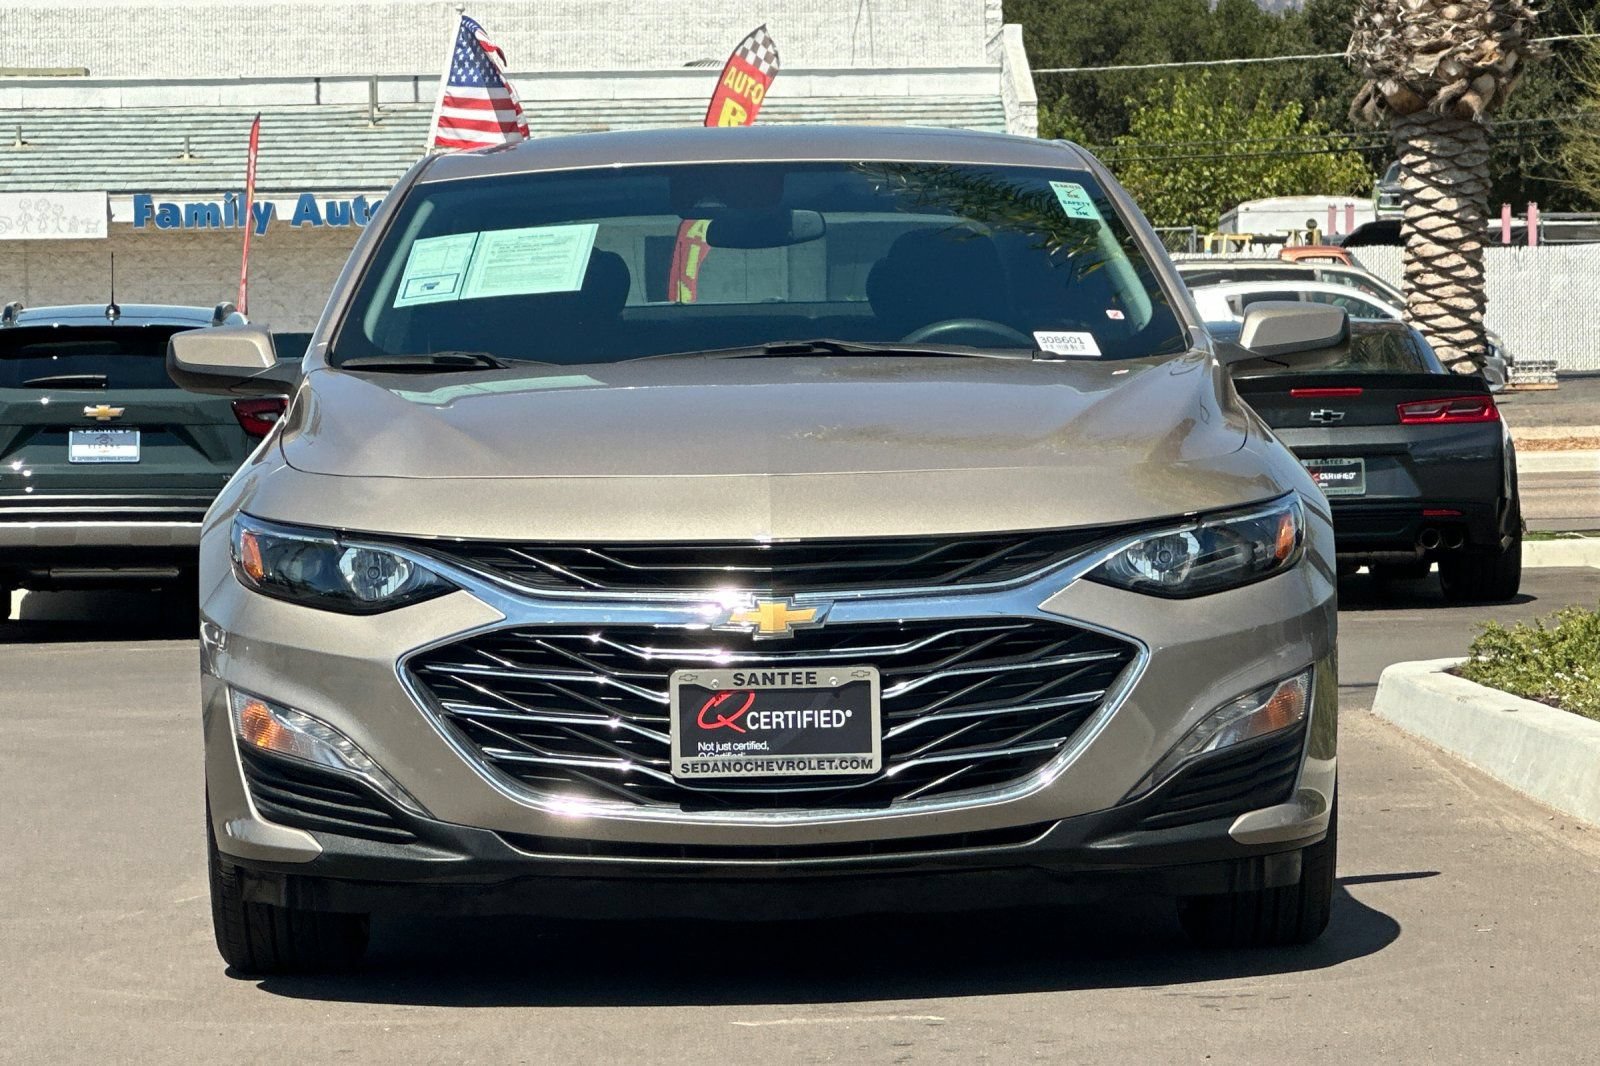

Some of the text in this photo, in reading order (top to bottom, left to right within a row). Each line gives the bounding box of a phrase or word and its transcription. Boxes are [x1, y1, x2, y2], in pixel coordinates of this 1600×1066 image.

[723, 65, 765, 105] AUTO
[133, 191, 274, 236] Family
[1039, 336, 1085, 344] 308601
[733, 671, 817, 686] SANTEE
[697, 741, 714, 751] Not
[715, 741, 731, 753] just
[681, 759, 873, 774] SEDANOCHEVROLET.COM
